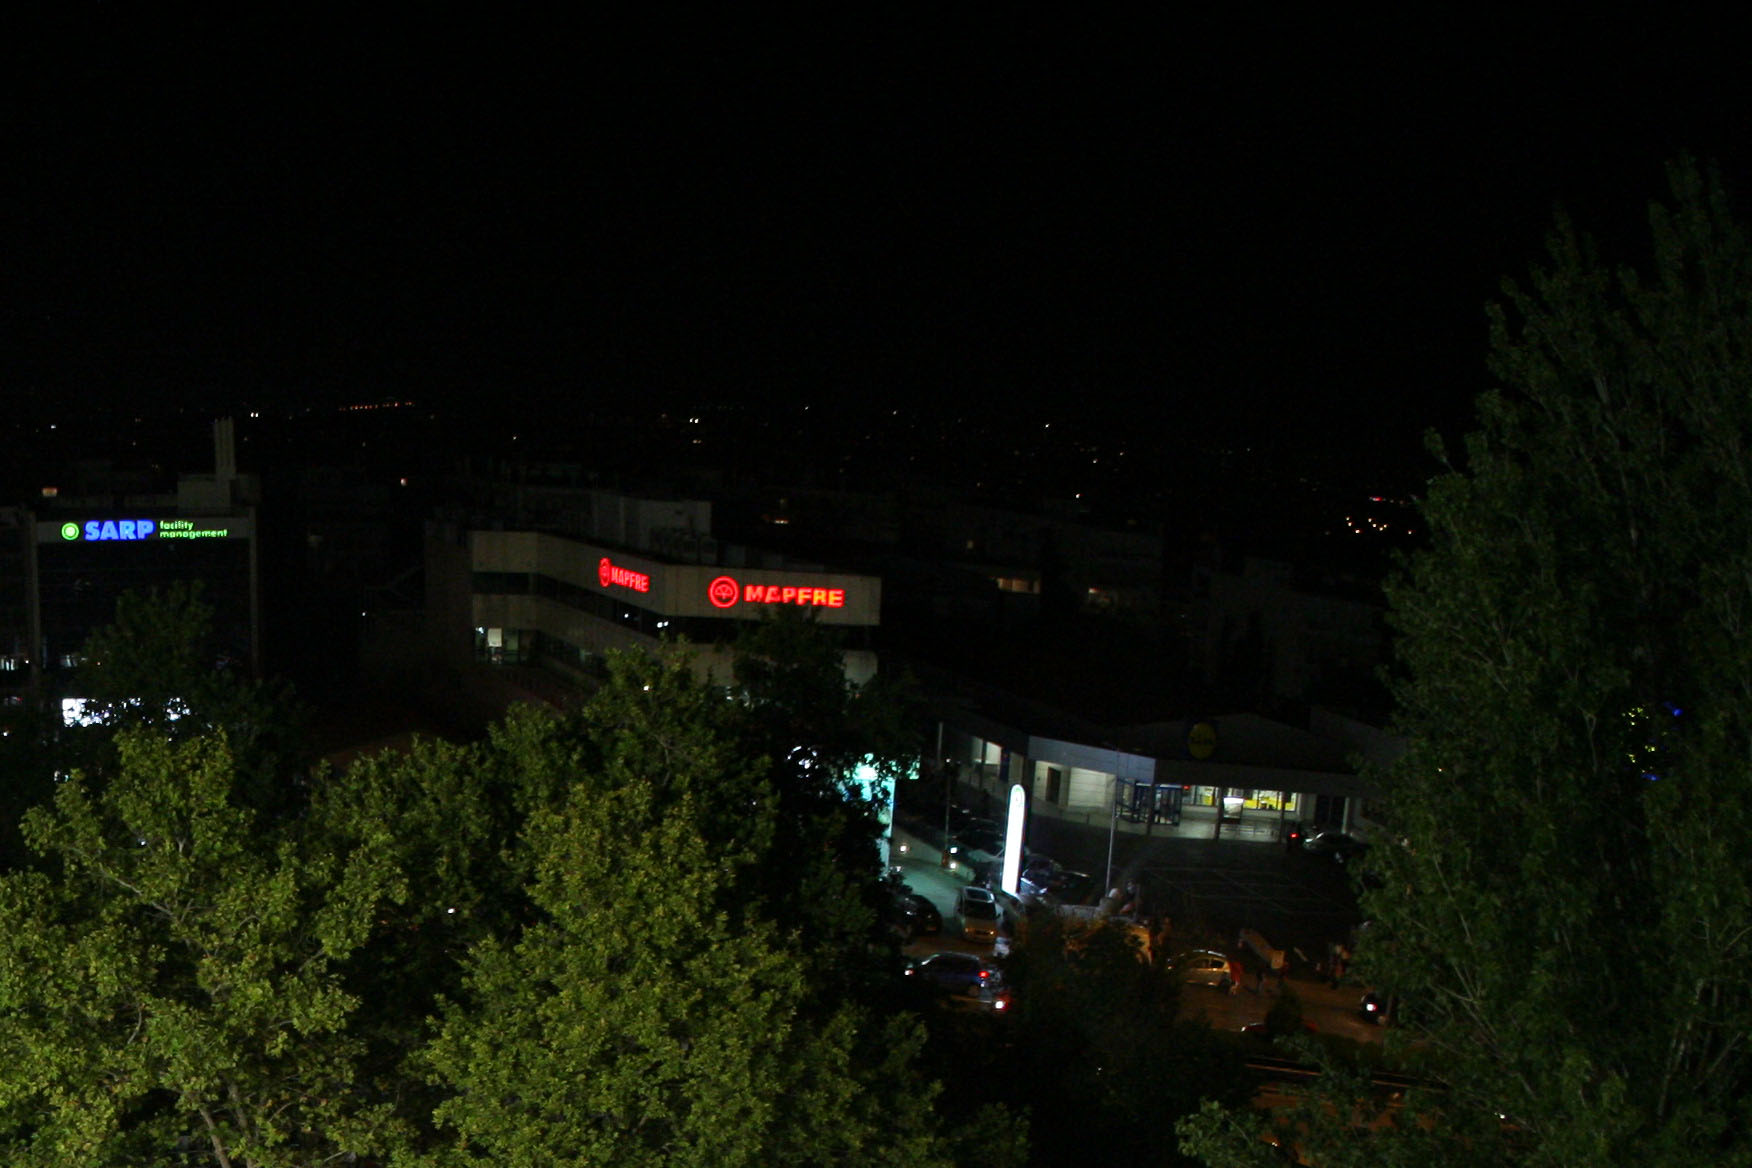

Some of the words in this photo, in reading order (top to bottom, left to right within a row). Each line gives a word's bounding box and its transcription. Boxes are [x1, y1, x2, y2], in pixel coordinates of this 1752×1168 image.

[84, 520, 155, 541] SARP
[159, 520, 193, 531] facility
[159, 528, 228, 540] management
[610, 565, 649, 593] MAPFRE
[743, 584, 845, 608] MAPFRE
